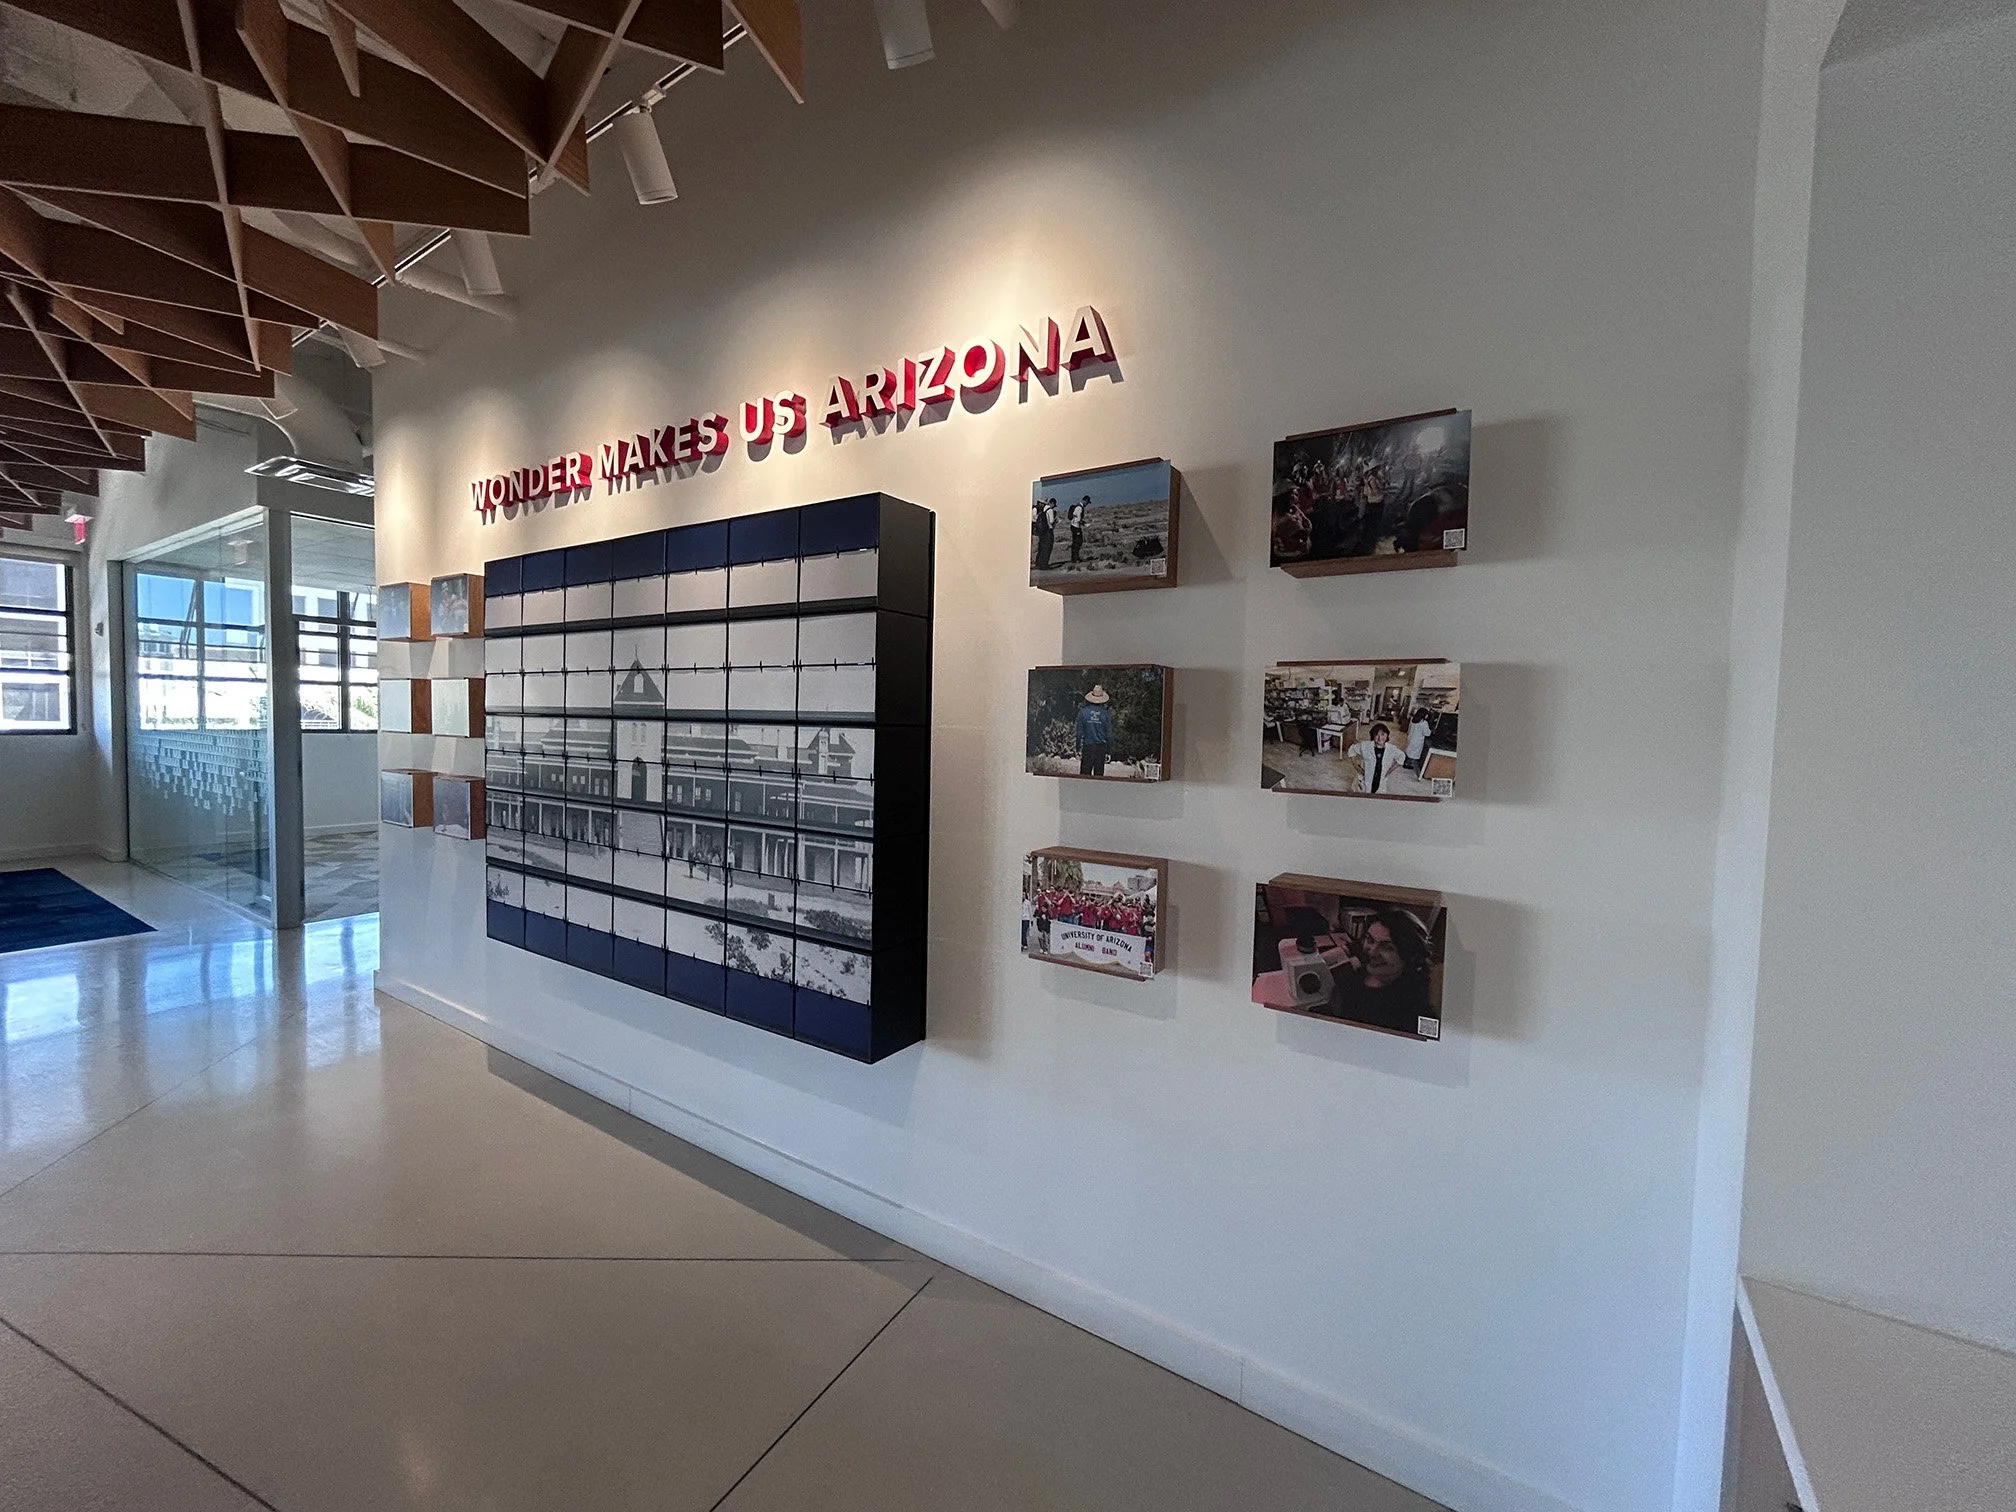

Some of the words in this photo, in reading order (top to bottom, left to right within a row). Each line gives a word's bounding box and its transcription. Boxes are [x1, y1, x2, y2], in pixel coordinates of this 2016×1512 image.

[471, 451, 593, 511] WONDER
[598, 412, 730, 481] MAKES
[739, 390, 806, 445] US
[819, 305, 1114, 428] ARIZONA
[1061, 931, 1095, 941] UNIVERSITY
[1096, 934, 1104, 942] OF
[1106, 936, 1132, 953] ARIZONA
